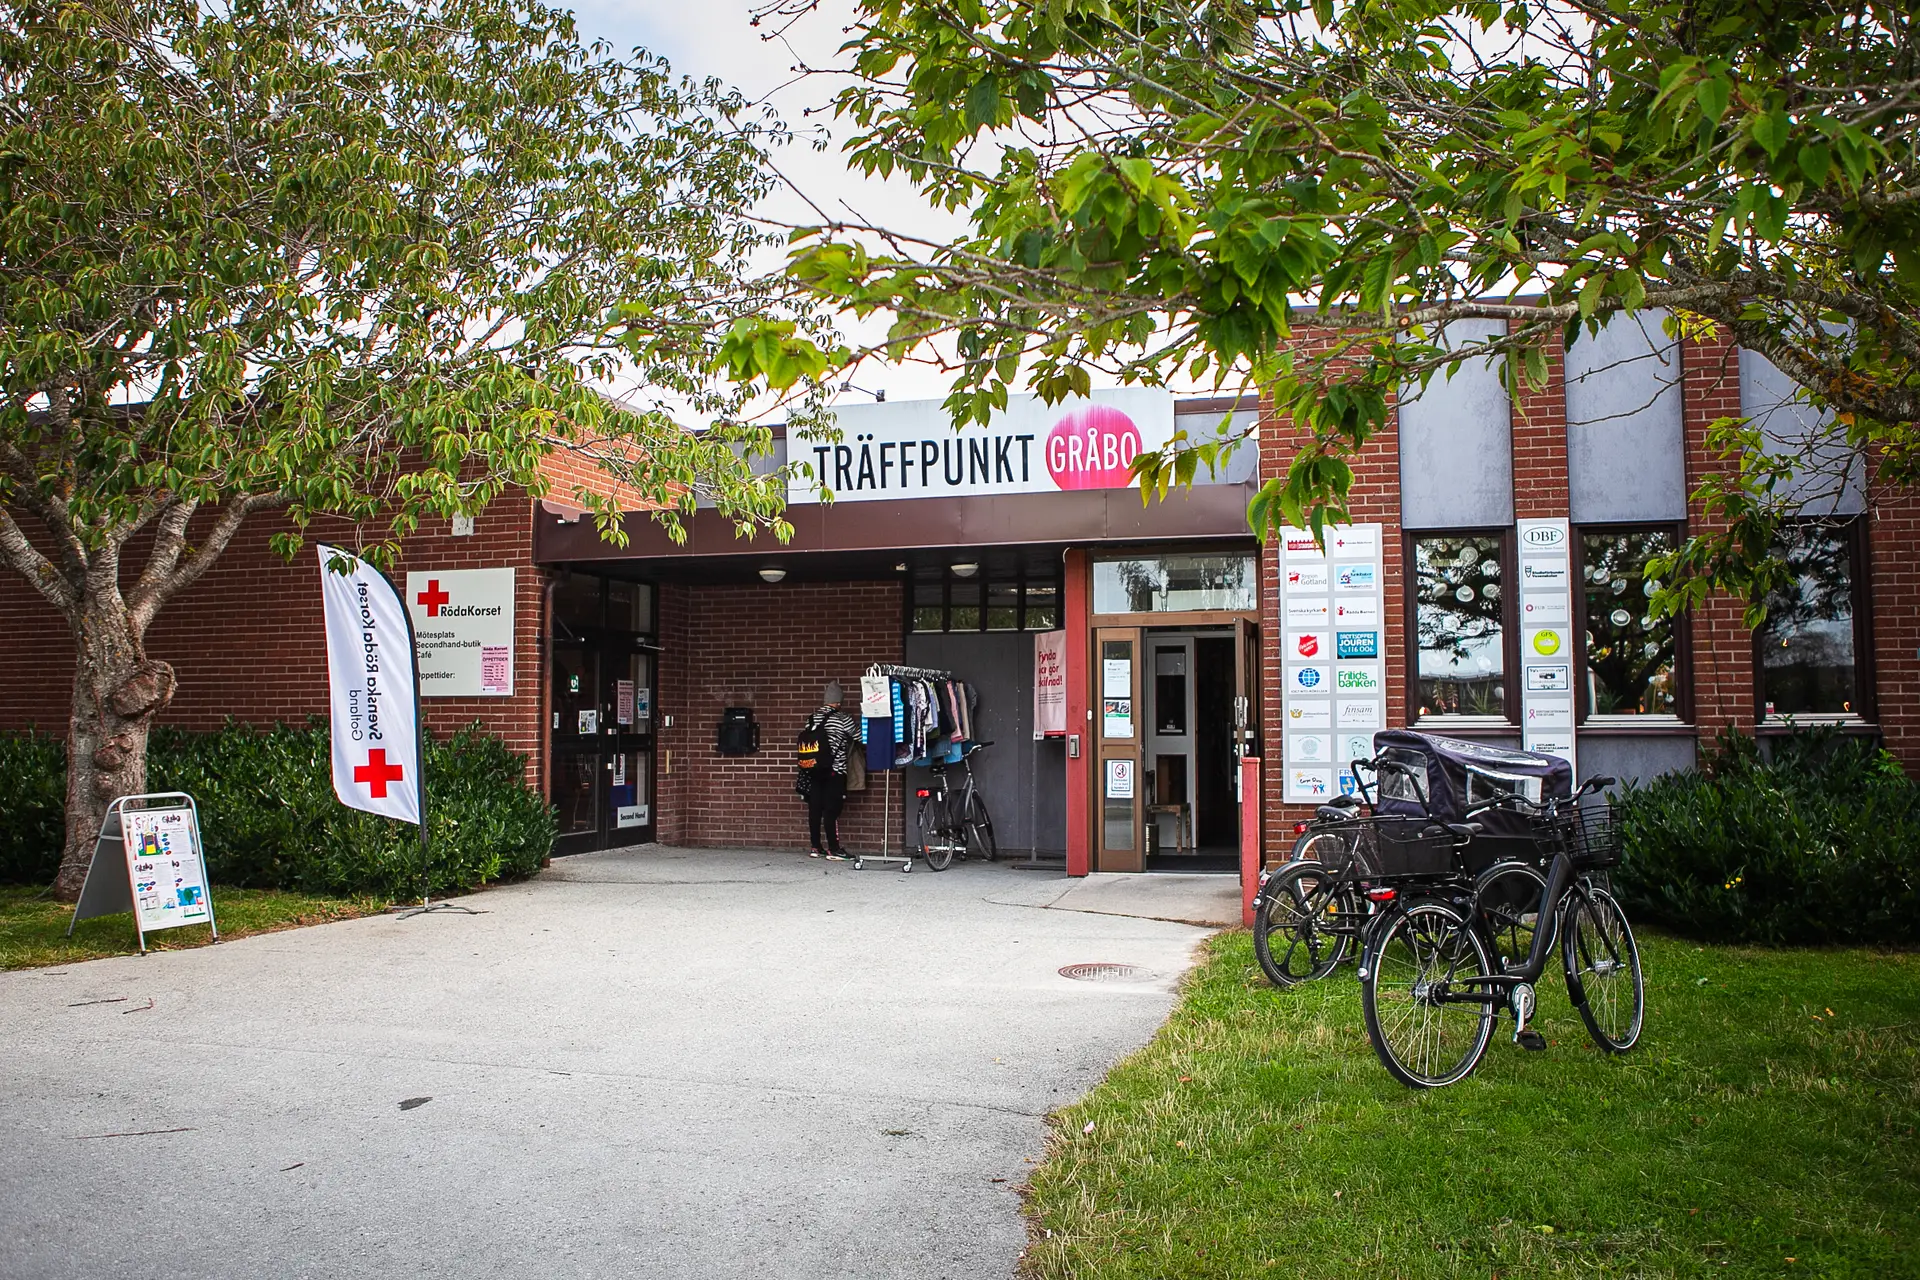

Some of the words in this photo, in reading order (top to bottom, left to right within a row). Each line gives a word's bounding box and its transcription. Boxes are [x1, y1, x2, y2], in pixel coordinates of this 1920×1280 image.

[813, 433, 1035, 492] TRÄFFPUNKT
[1050, 427, 1138, 474] GRÅBO
[1531, 531, 1557, 541] DBF
[440, 605, 502, 617] RödaKorset
[416, 631, 455, 640] Mötesplats
[416, 640, 482, 649] Secondhand-butik
[1038, 649, 1056, 664] Fynda
[419, 672, 456, 681] ppettider:
[1338, 671, 1368, 680] Fritids
[1338, 679, 1377, 688] banken
[620, 811, 635, 821] Second
[634, 810, 646, 820] Hand
